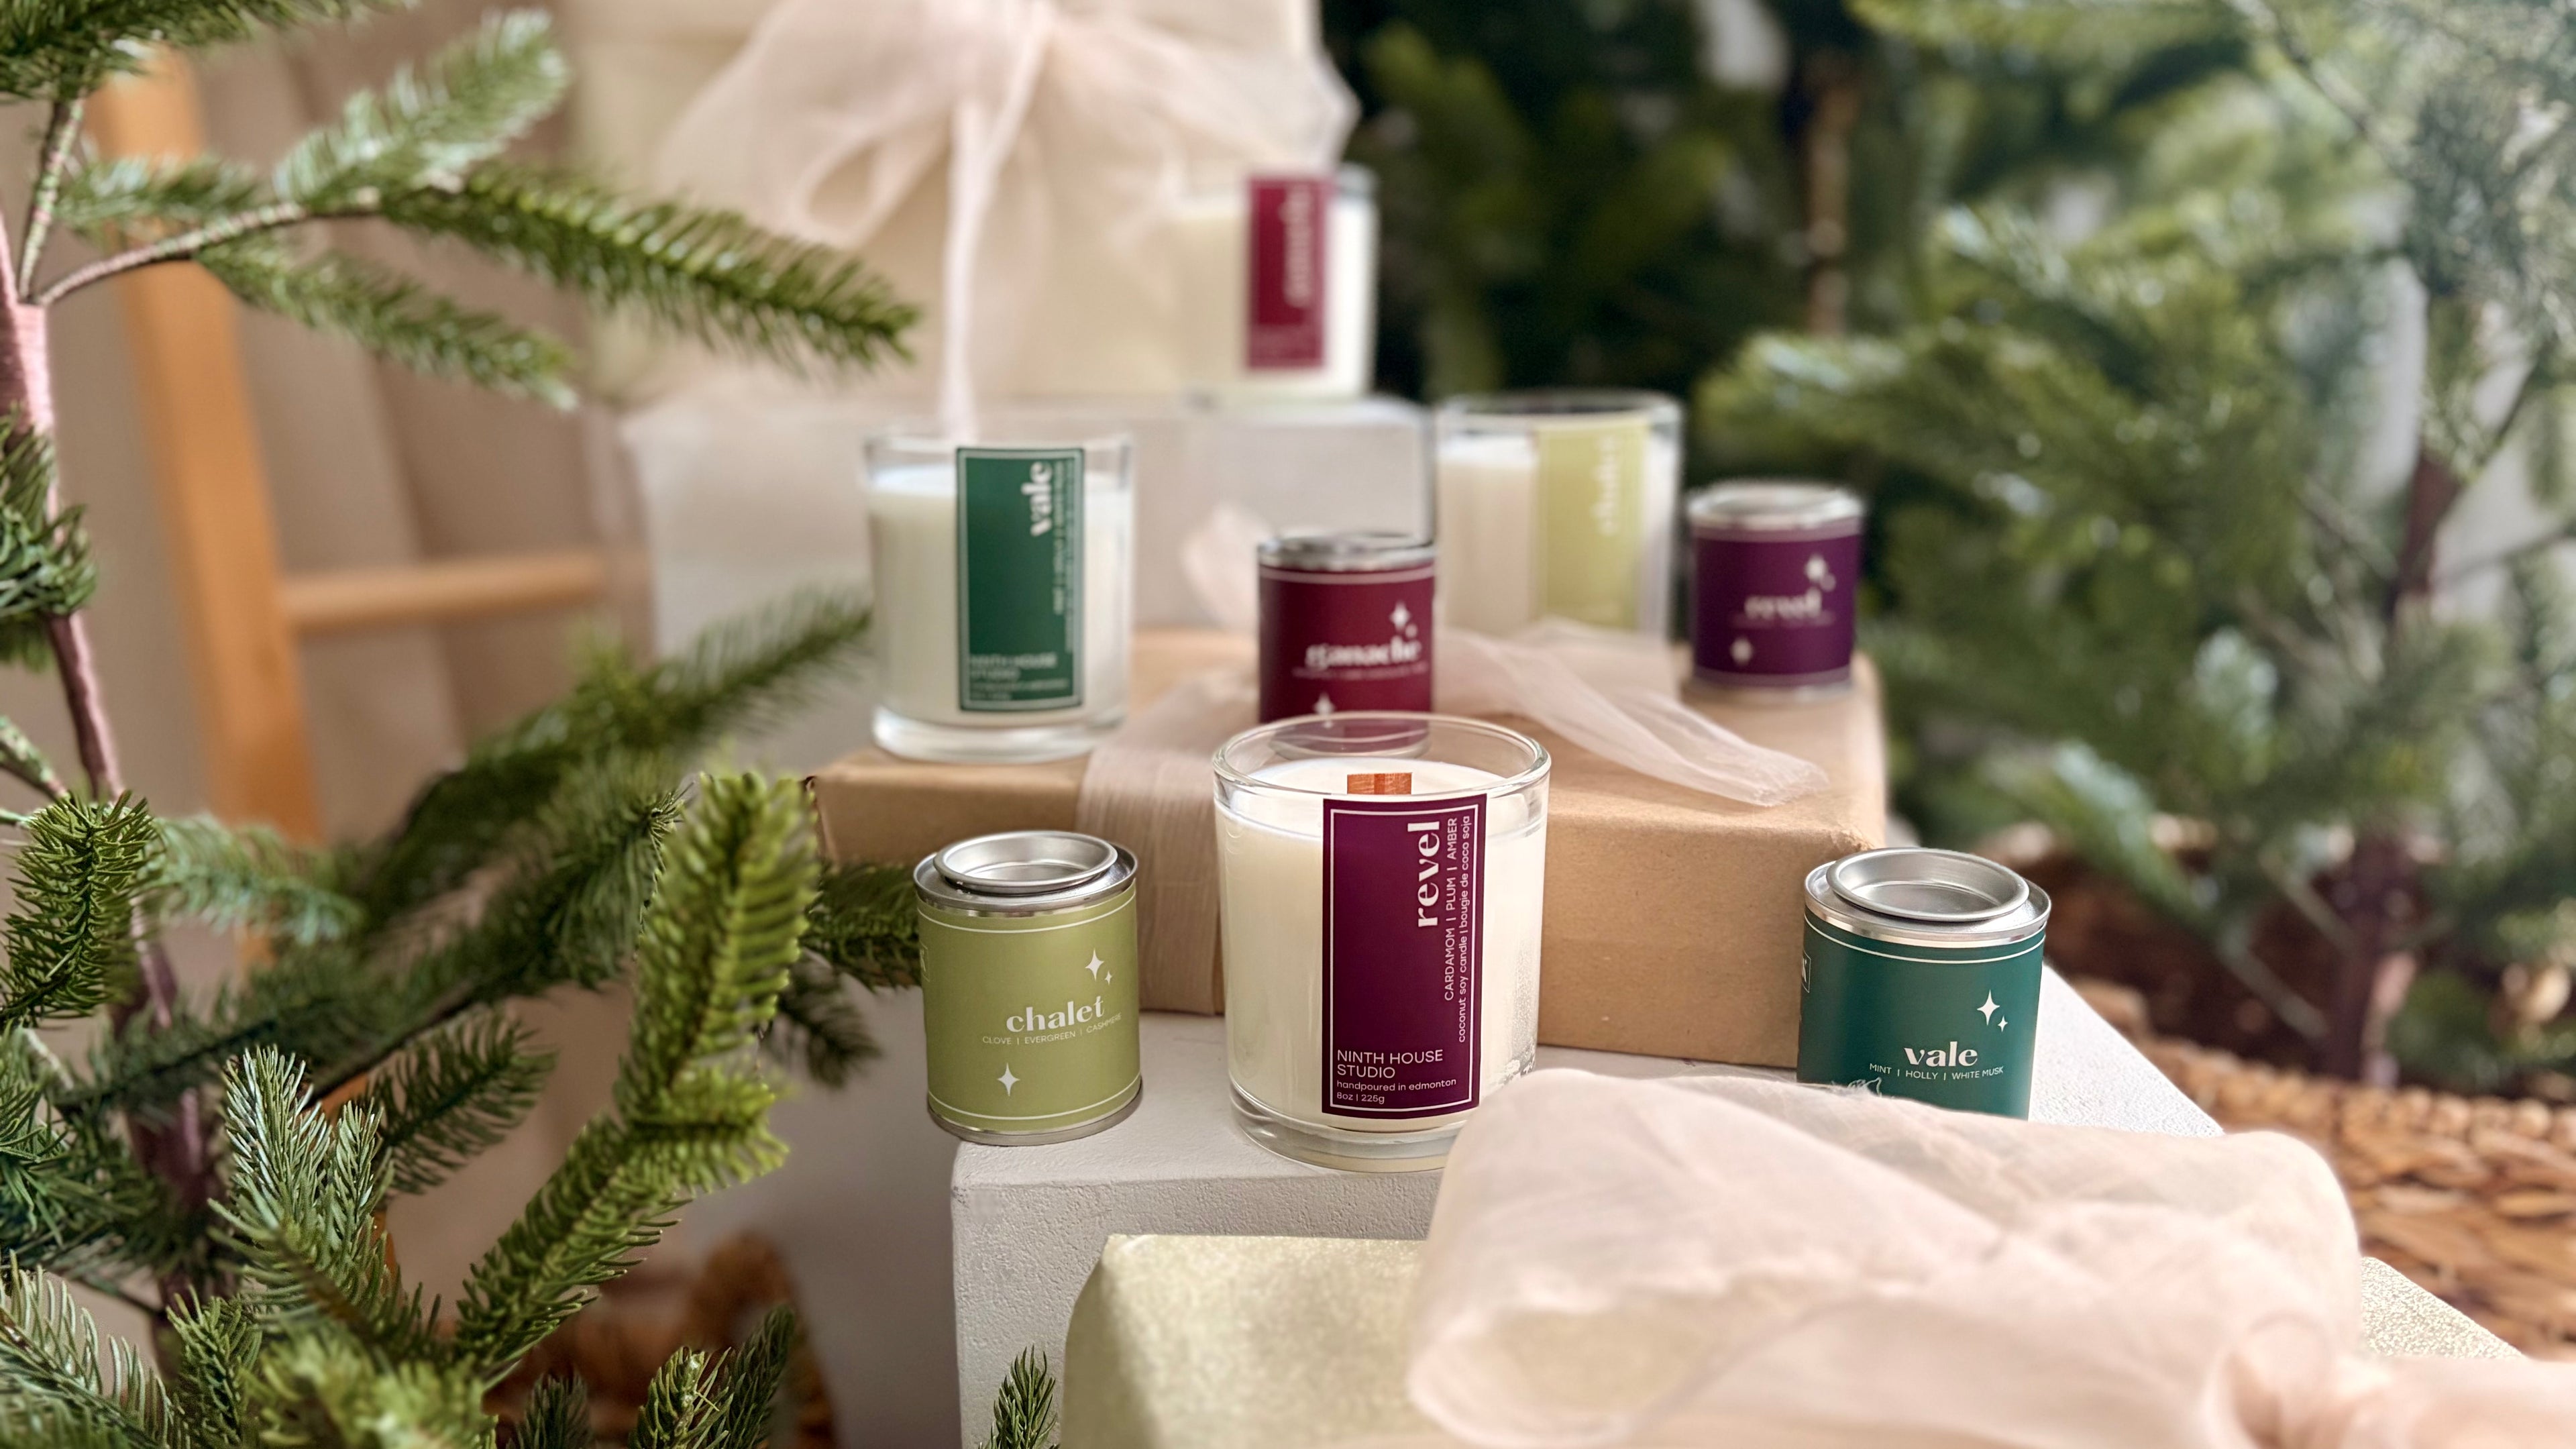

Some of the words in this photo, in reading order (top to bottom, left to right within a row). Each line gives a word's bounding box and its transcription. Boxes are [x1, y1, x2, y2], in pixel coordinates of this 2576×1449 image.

[1021, 462, 1052, 536] vale
[1447, 818, 1458, 860] AMBER
[1461, 816, 1472, 839] soja
[1407, 821, 1440, 927] revel
[1460, 873, 1468, 888] de
[1446, 877, 1456, 911] PLUM
[1459, 890, 1470, 928] bougie
[1444, 928, 1455, 1001] CARDAMOM
[1458, 936, 1467, 973] candle
[1460, 976, 1468, 995] soy
[982, 1036, 1012, 1044] CLOVE
[1024, 1030, 1076, 1044] EVERGREEN
[1086, 1012, 1122, 1033] CASHMERE
[1006, 996, 1105, 1032] chalet
[1458, 997, 1466, 1042] coconut
[1337, 1049, 1384, 1064] NINTH
[1389, 1049, 1444, 1065] HOUSE
[1904, 1041, 1978, 1067] vale
[1337, 1064, 1395, 1079] STUDIO
[1337, 1080, 1395, 1091] handpoured
[1398, 1083, 1406, 1091] in
[1409, 1079, 1456, 1091] edmonton
[1870, 1063, 1892, 1074] MINT
[1906, 1070, 1939, 1079] HOLLY
[1951, 1071, 1980, 1080] WHITE
[1982, 1066, 2004, 1077] MUSK
[1337, 1092, 1353, 1101] 8oz
[1361, 1094, 1385, 1104] 225g
